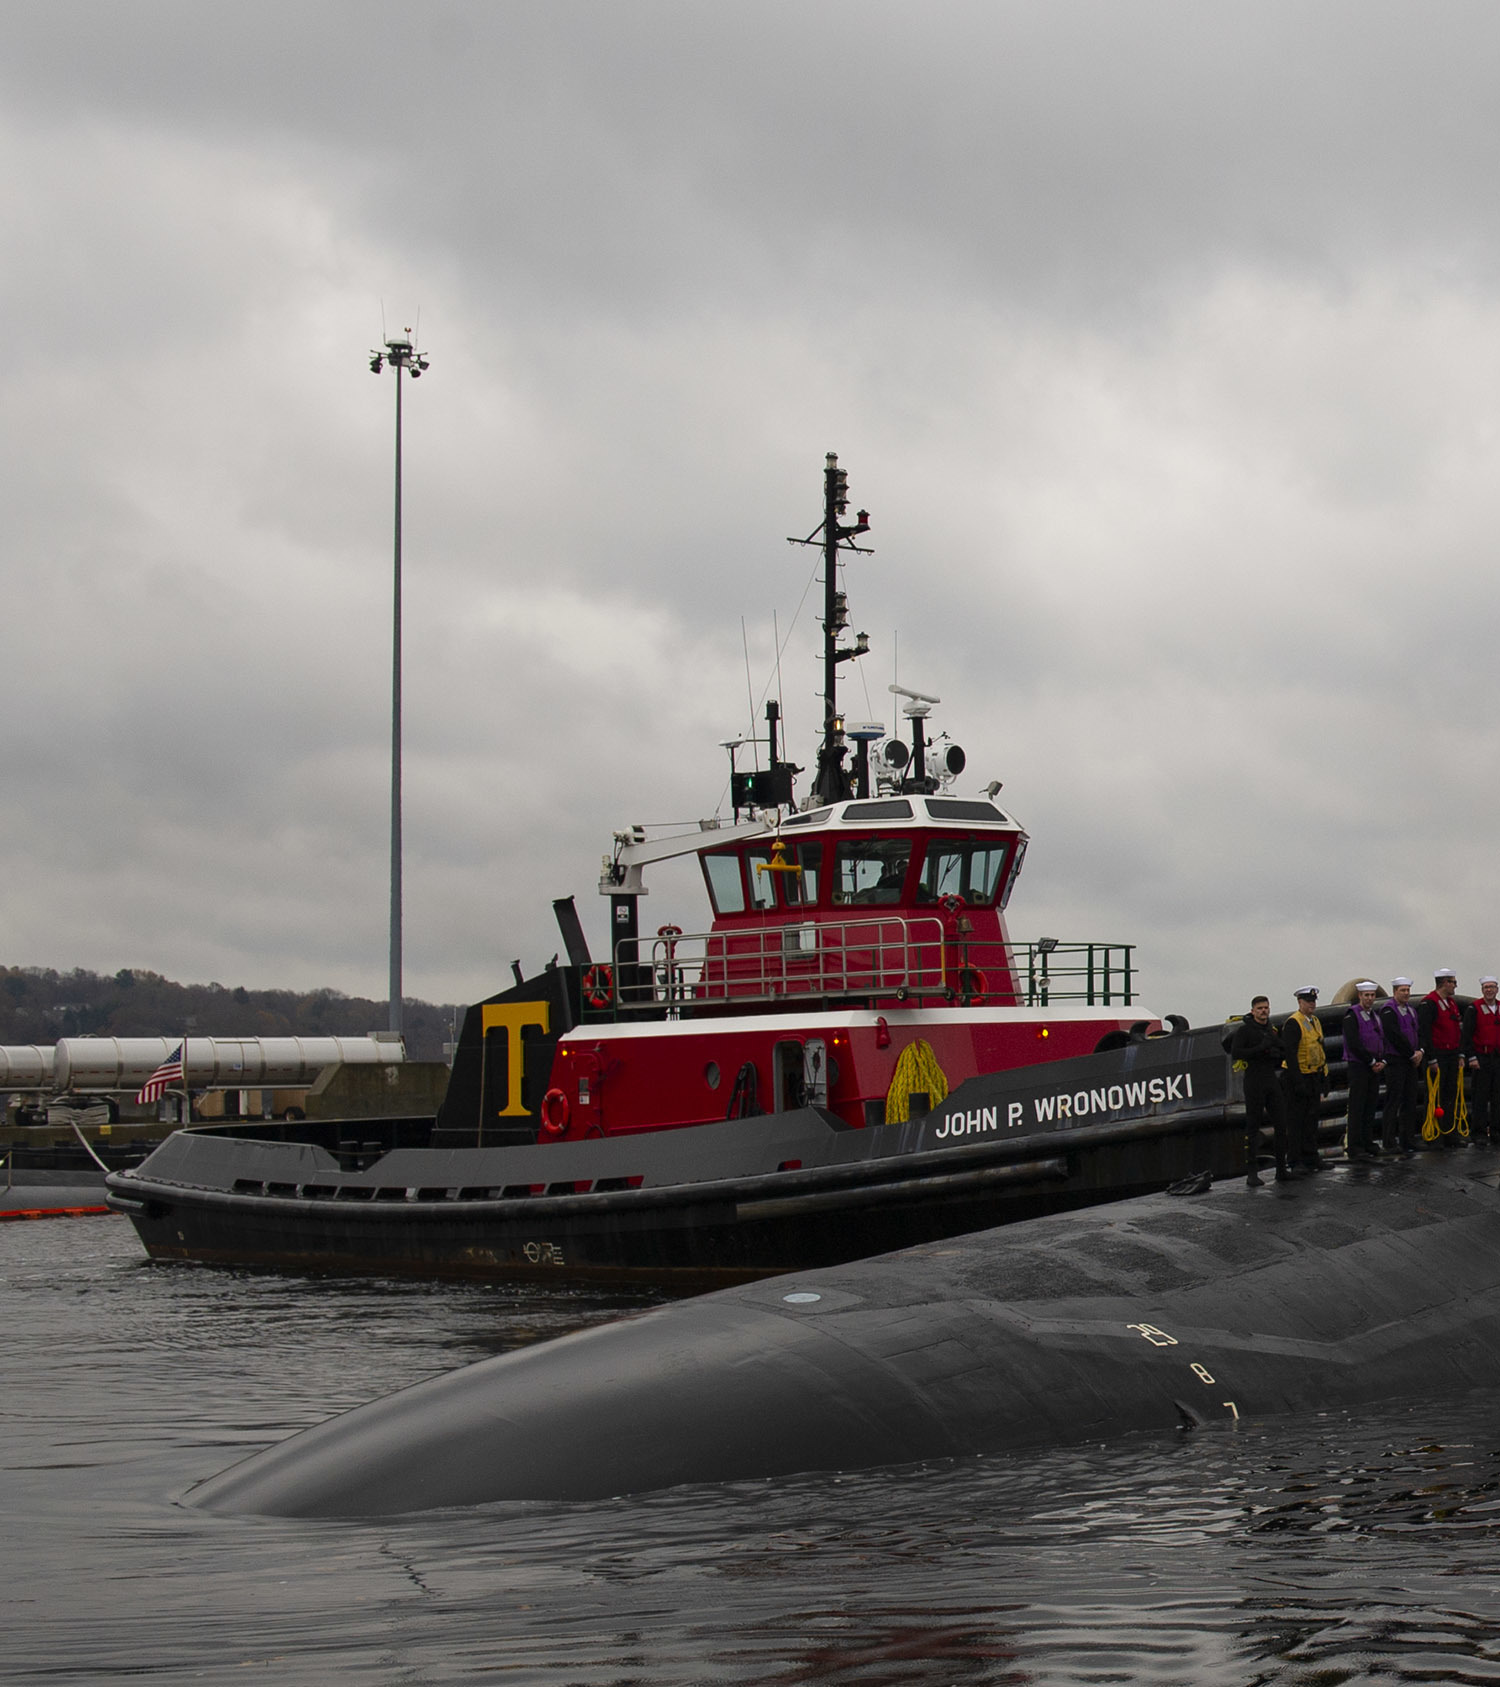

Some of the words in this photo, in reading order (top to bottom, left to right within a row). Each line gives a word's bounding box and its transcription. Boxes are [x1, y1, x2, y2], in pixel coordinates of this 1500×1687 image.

[482, 1001, 550, 1116] T
[936, 1106, 997, 1139] JOHN
[1008, 1103, 1023, 1127] P.
[1035, 1073, 1193, 1122] WRONOWSKI
[1127, 1323, 1178, 1346] 29
[1190, 1363, 1215, 1384] 8
[1223, 1402, 1239, 1420] 7
